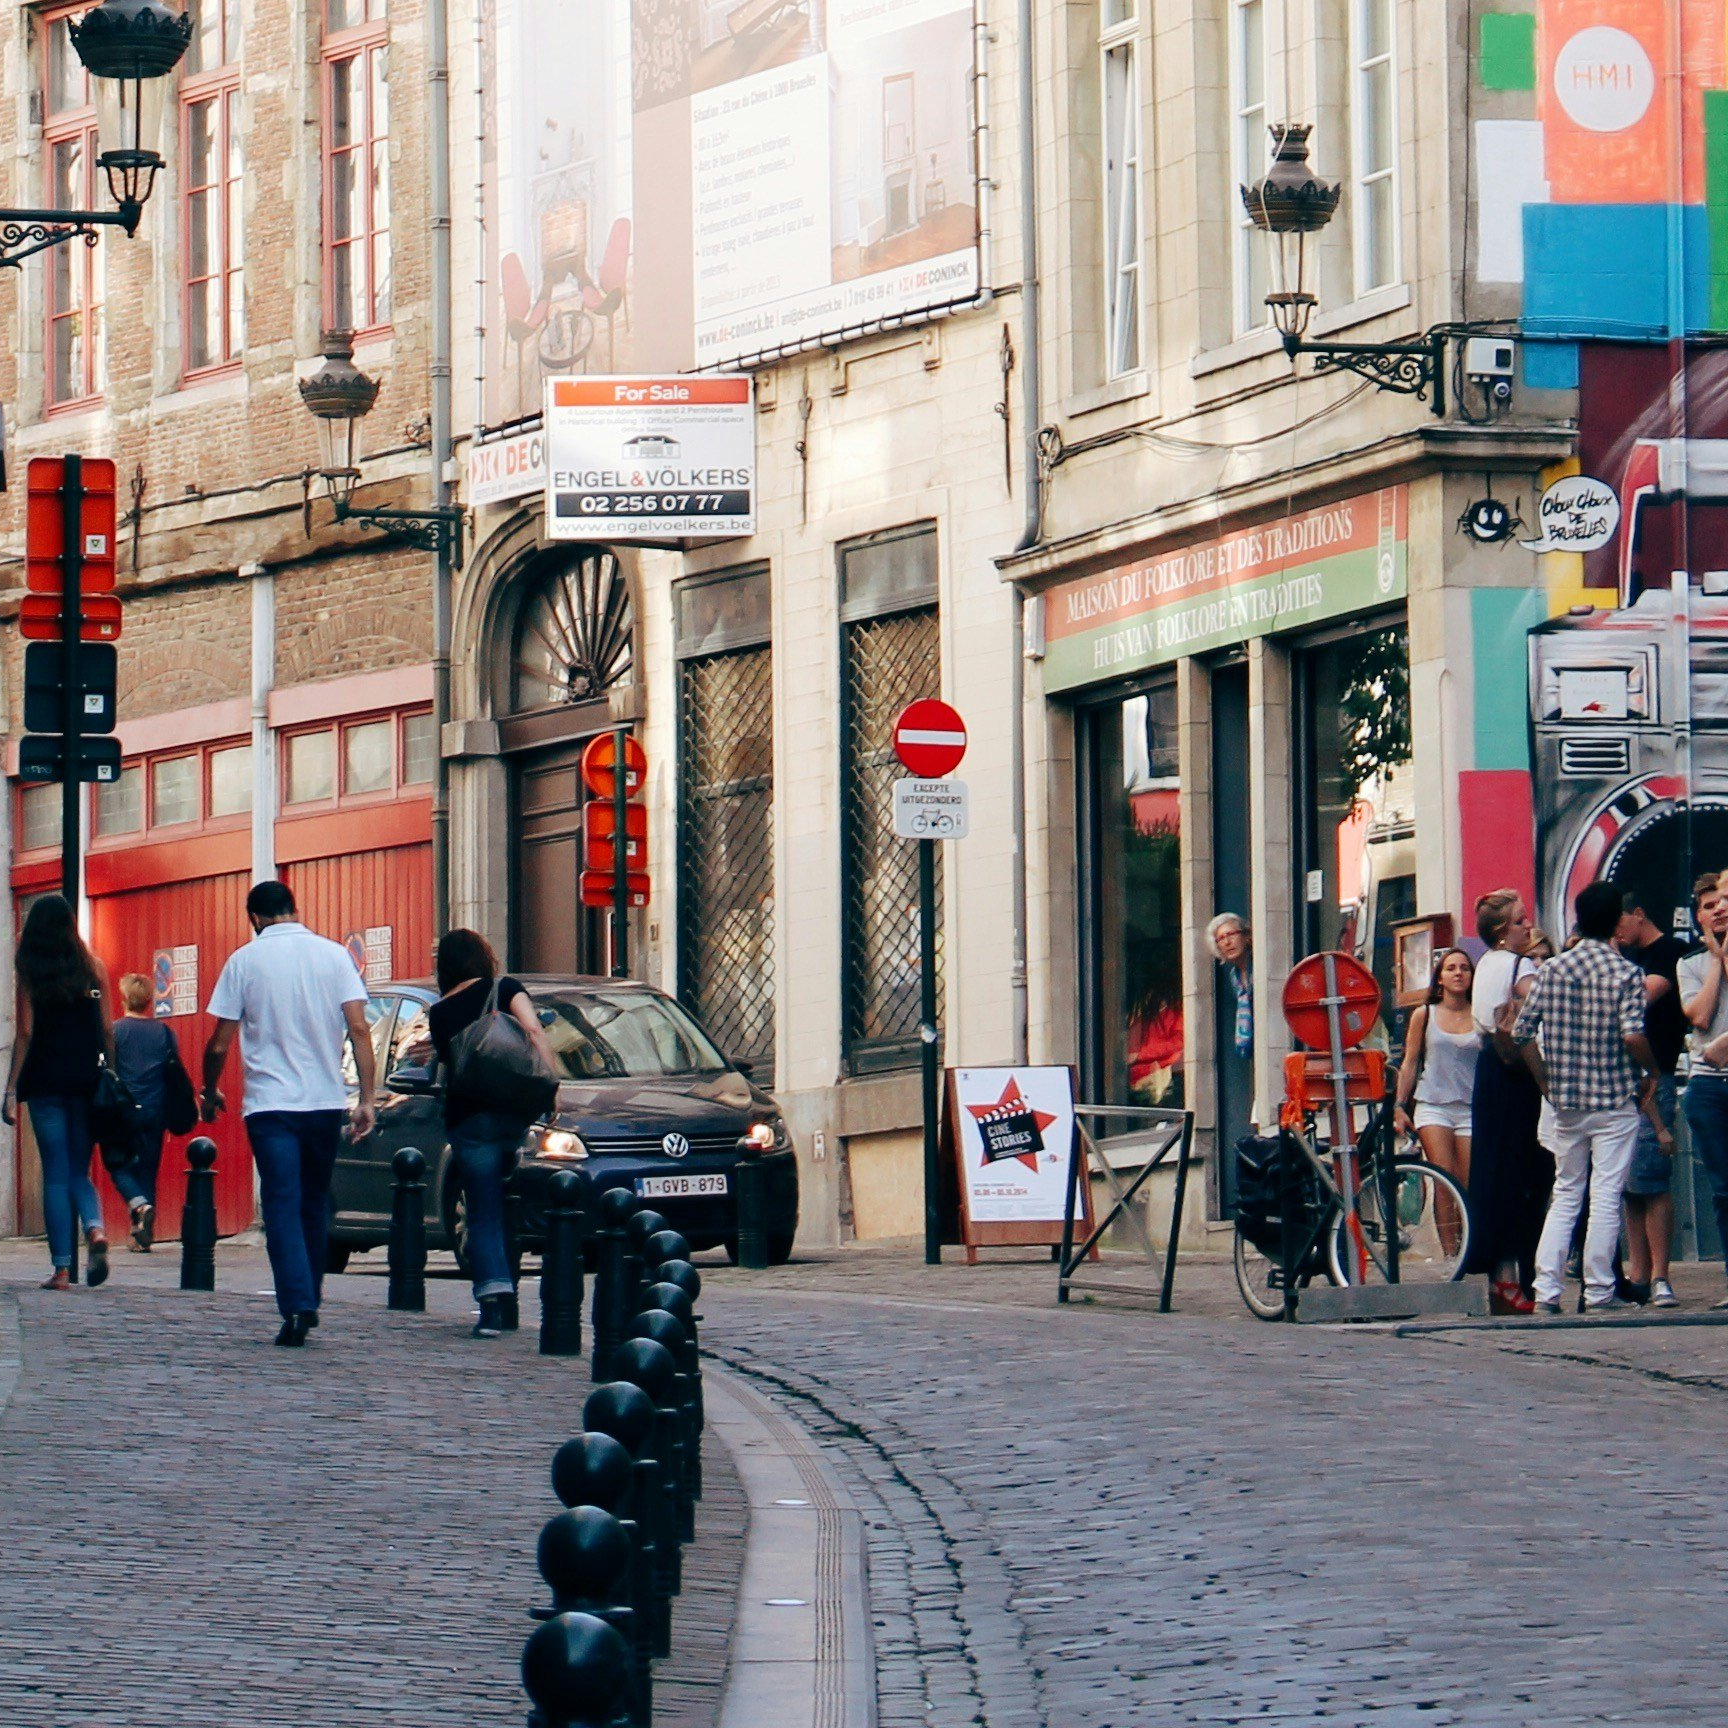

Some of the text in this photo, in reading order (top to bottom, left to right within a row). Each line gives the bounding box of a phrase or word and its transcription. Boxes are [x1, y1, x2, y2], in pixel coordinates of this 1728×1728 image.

[614, 385, 690, 401] For Sale
[616, 407, 661, 416] Apartments
[580, 494, 724, 512] 02 256 07 77
[556, 519, 751, 533] www.engelvoelkers.be
[1567, 512, 1587, 525] DE
[1548, 517, 1607, 541] BRUXELLES
[1066, 580, 1119, 624] MAISON
[1120, 575, 1141, 607] DU
[1144, 550, 1215, 599] FOLKLORE
[1217, 540, 1236, 575] ET
[1237, 535, 1263, 568] DES
[1264, 507, 1354, 562] TRADITIONS
[1093, 573, 1323, 670] HUIS VAN FOLKLORE EN TRADITIES
[902, 795, 962, 804] UITGEZONDERD
[990, 1130, 1032, 1150] STORIES
[645, 1177, 725, 1194] 1-GVB-879
